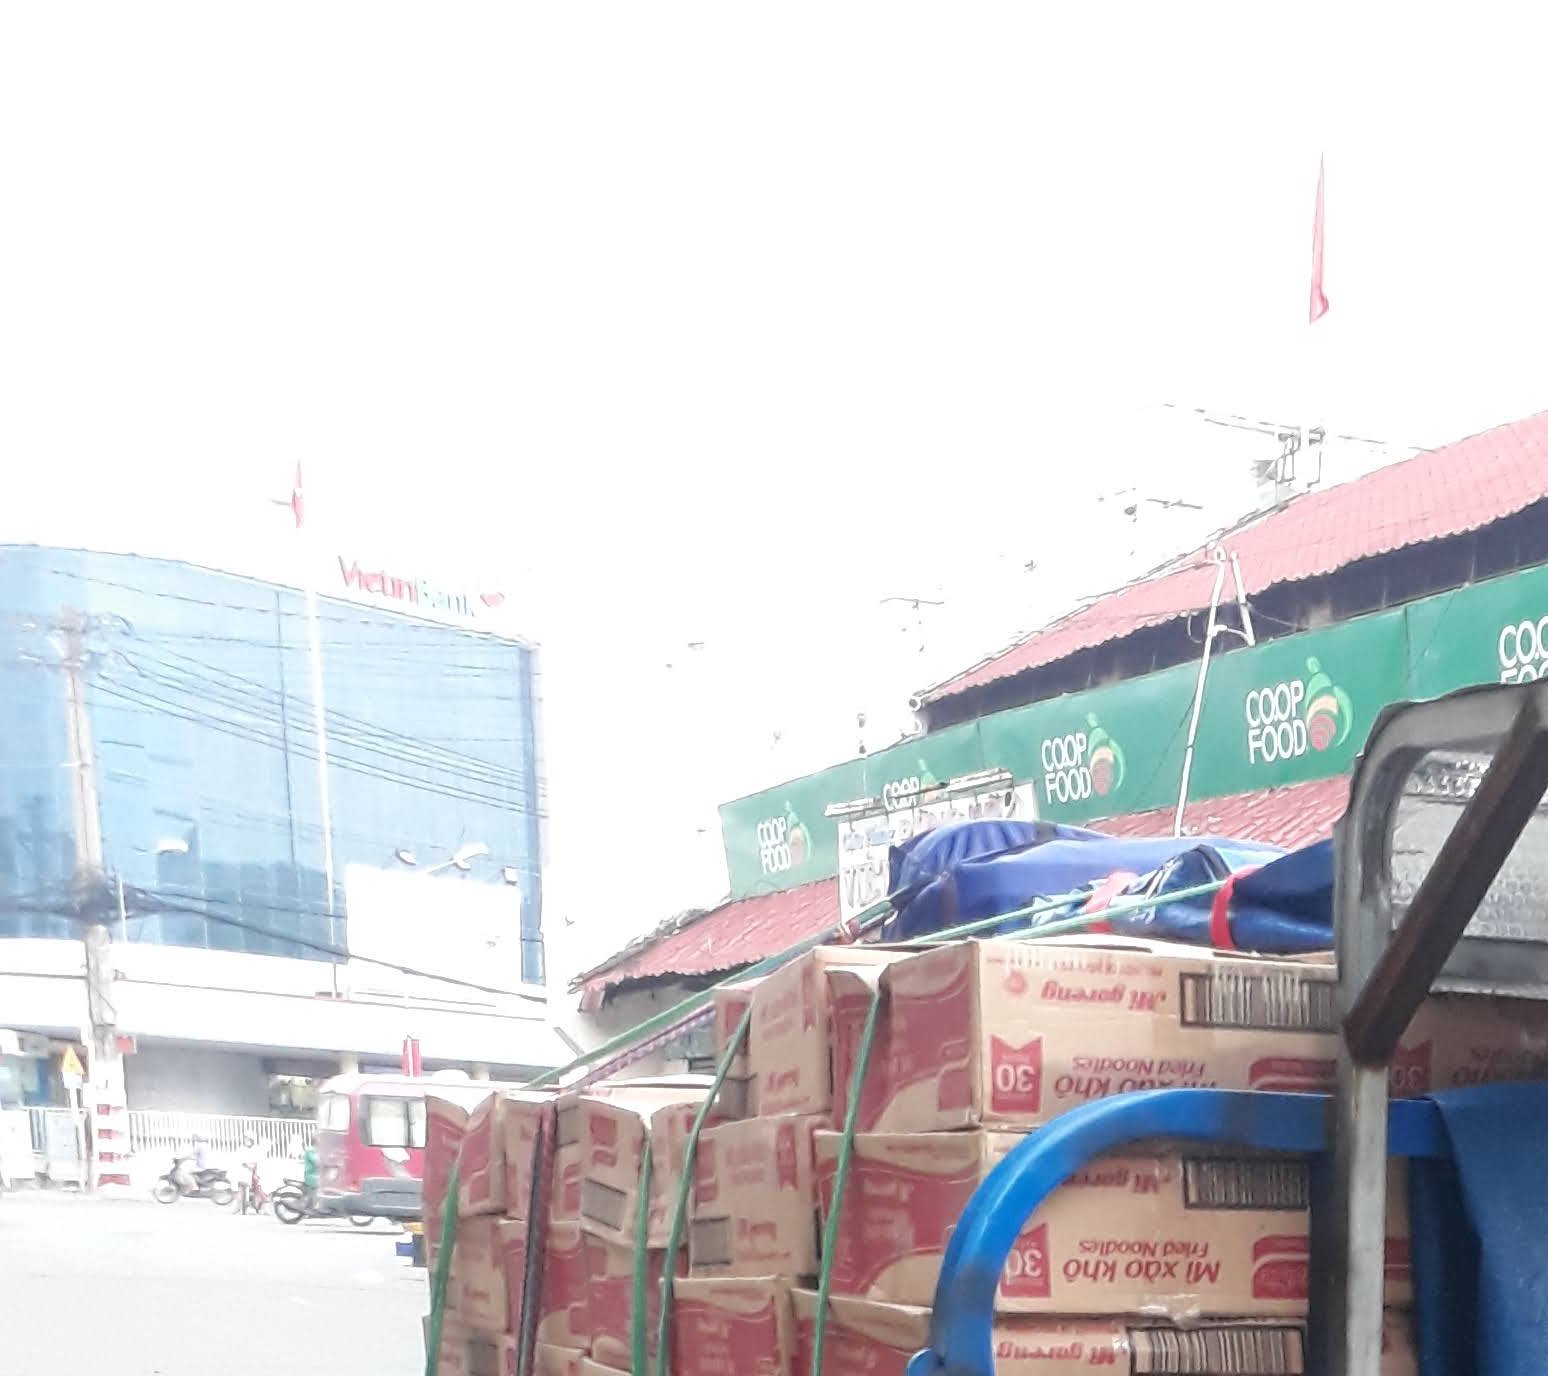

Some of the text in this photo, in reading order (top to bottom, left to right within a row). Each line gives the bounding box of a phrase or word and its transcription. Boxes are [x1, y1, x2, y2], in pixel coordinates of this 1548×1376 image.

[1248, 719, 1308, 766] FOOD
[1045, 766, 1093, 806] FOOD
[760, 843, 792, 875] FOOD
[996, 1065, 1034, 1093] 30
[1073, 1056, 1206, 1077] Fried Noodles
[1079, 1239, 1209, 1258] Fried Noodles
[1062, 1259, 1220, 1284] Mì xào khô
